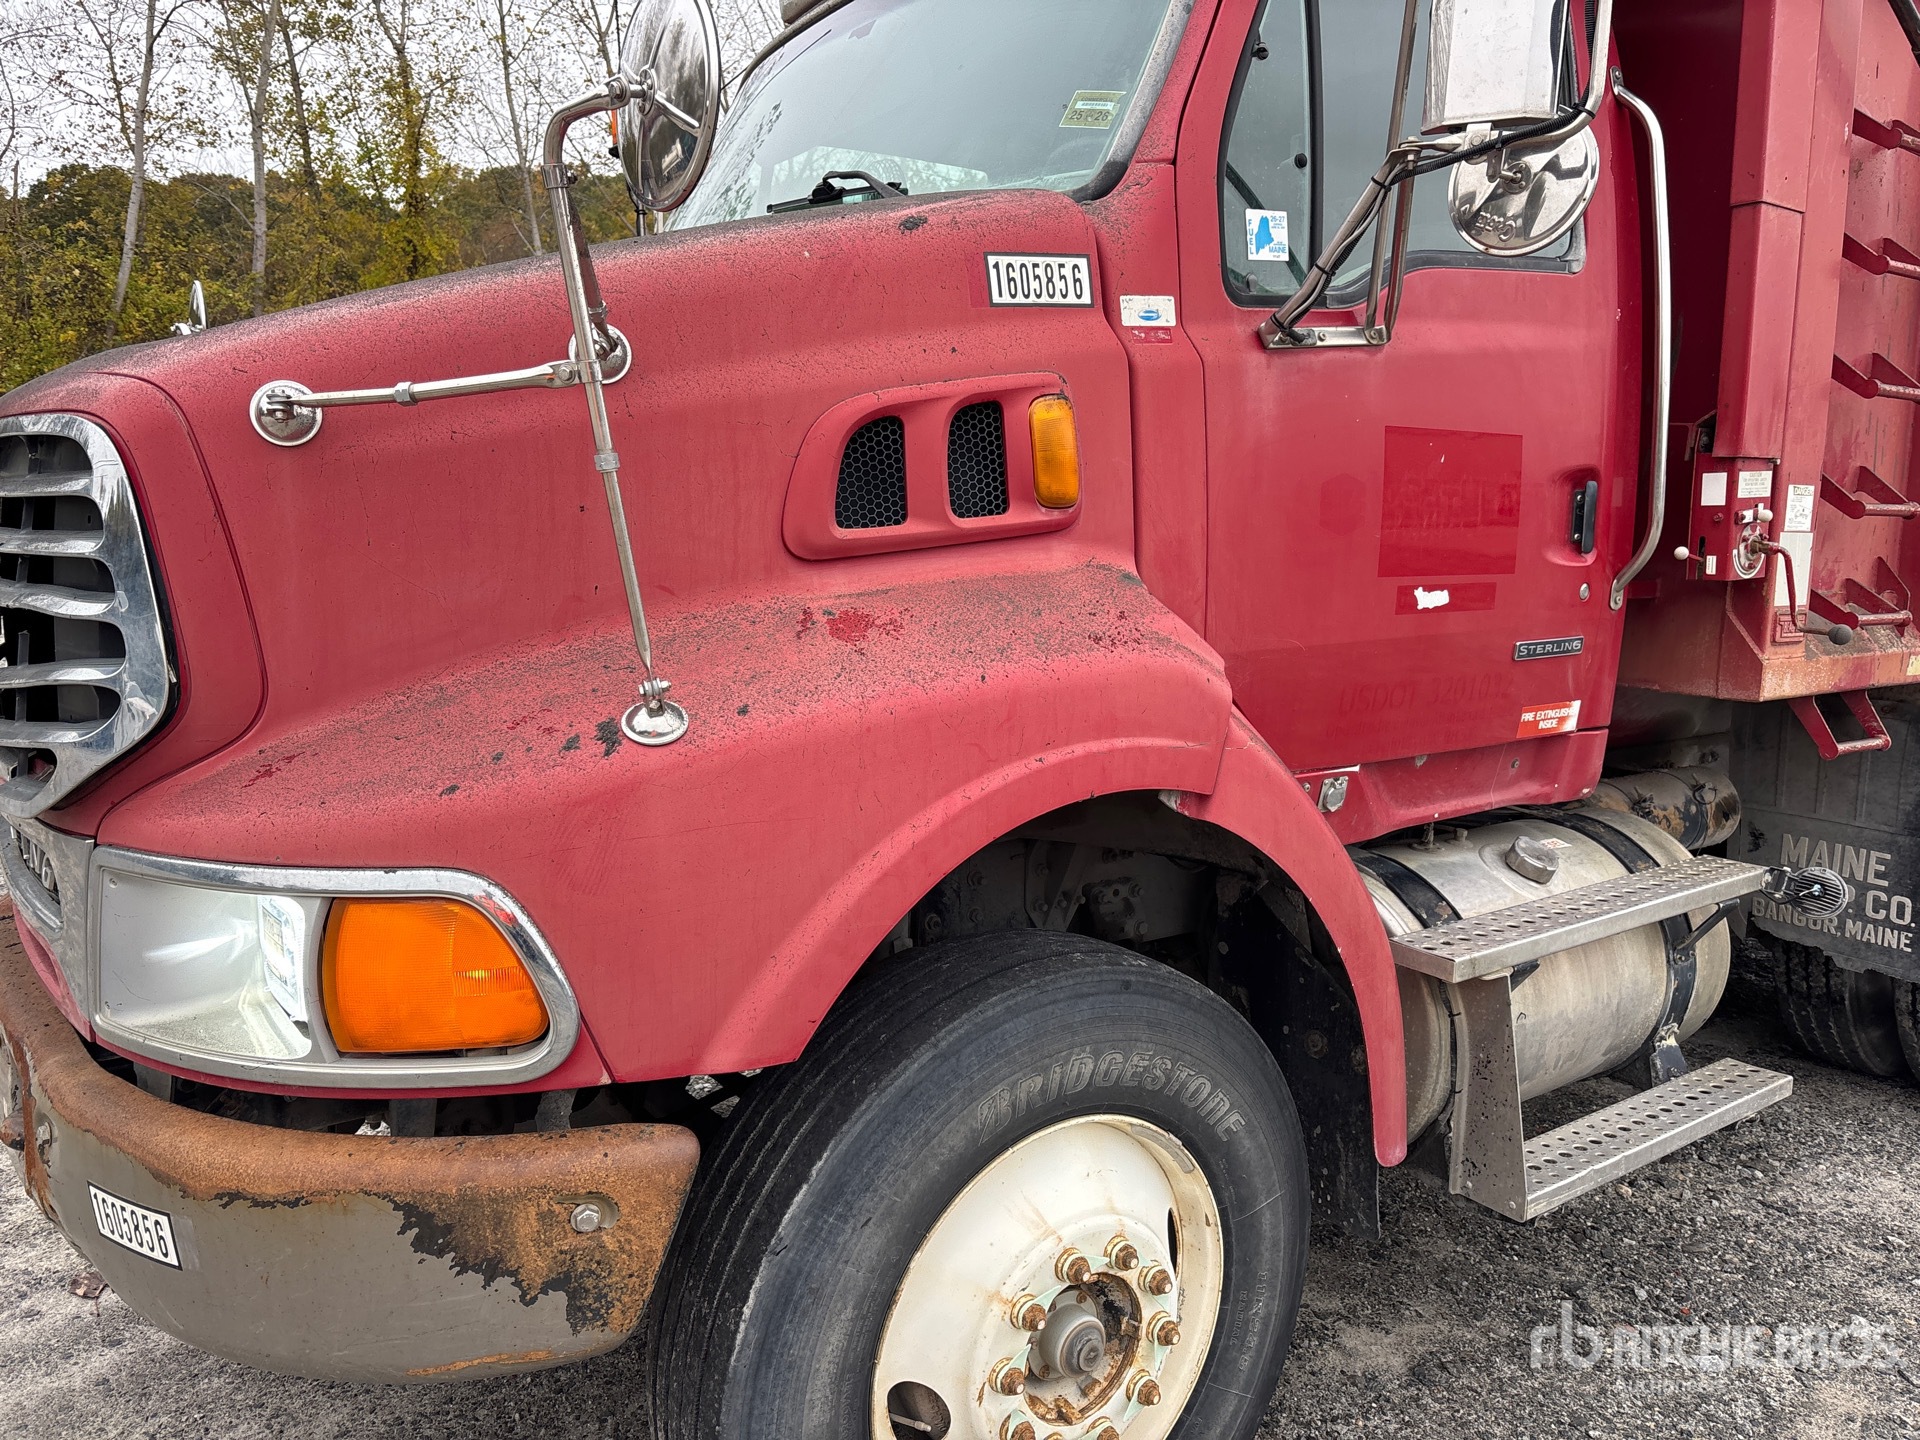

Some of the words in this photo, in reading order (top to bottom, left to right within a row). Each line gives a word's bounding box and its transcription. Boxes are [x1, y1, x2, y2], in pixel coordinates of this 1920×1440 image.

[1069, 110, 1085, 120] 25
[1094, 110, 1110, 121] 26
[992, 260, 1083, 300] 1605856
[1519, 640, 1582, 656] STERLING
[1338, 680, 1421, 717] USDOT
[1520, 712, 1535, 723] FIRE
[1538, 718, 1559, 730] INSIDE
[1780, 833, 1892, 887] MAINE
[1752, 897, 1841, 937] BANGOR,
[1845, 918, 1913, 953] MAINE
[1865, 889, 1916, 928] CO.
[977, 1050, 1247, 1146] BRIDGESTONE
[93, 1191, 169, 1259] 1605856
